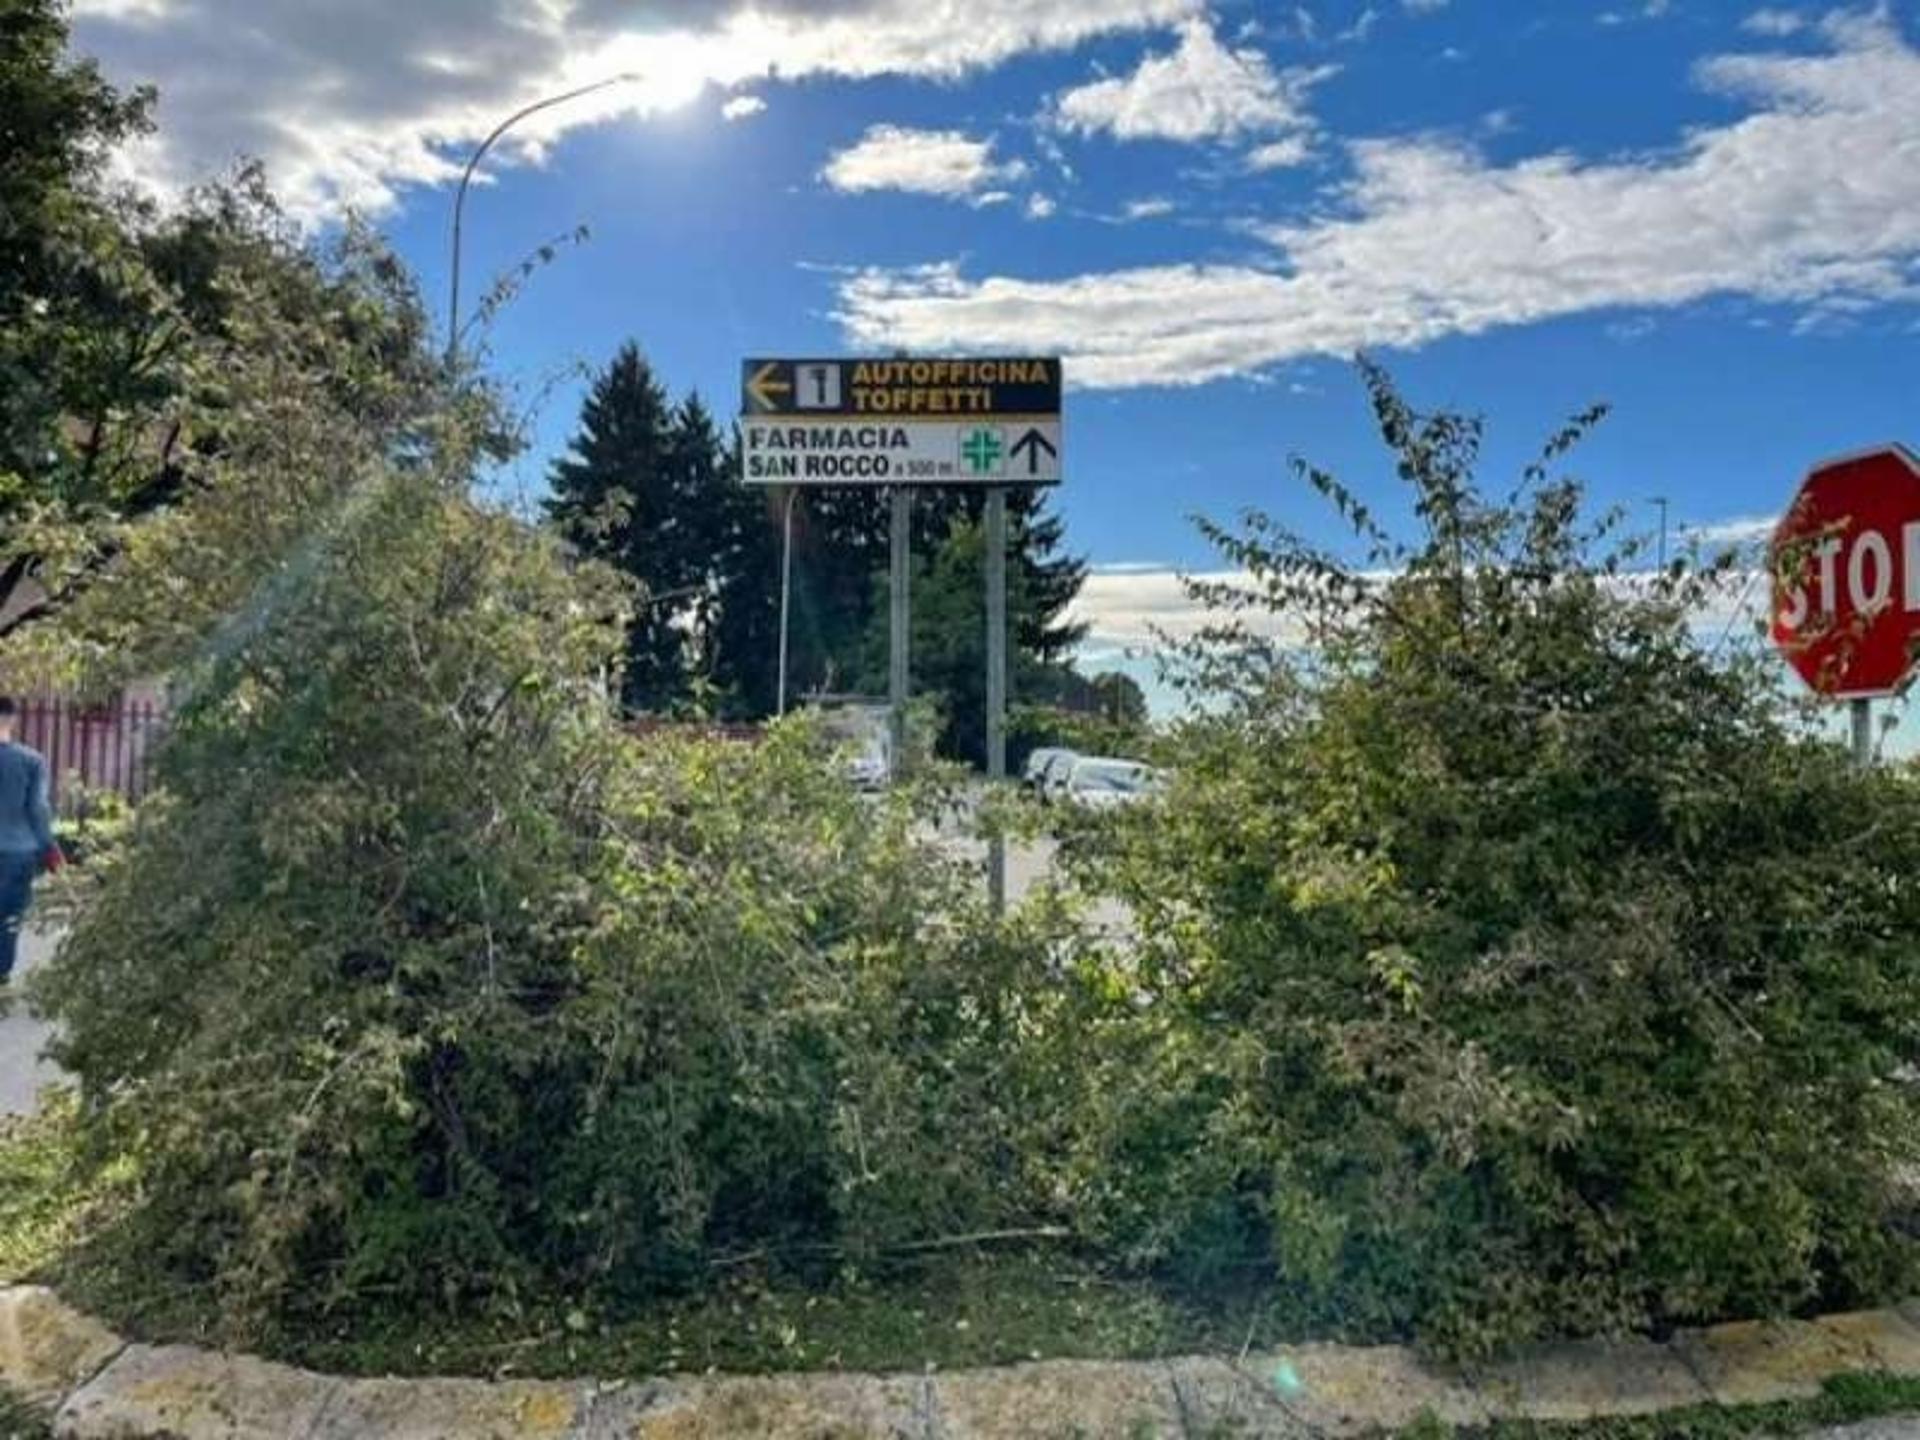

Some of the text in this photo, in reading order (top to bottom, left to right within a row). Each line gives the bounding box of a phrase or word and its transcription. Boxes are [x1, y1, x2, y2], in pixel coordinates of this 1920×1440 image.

[852, 362, 1050, 383] AUTOFFICINA
[852, 387, 991, 411] TOFFETTI
[750, 427, 910, 449] FARMACIA
[750, 454, 797, 477] SAN
[805, 454, 889, 477] ROCCO
